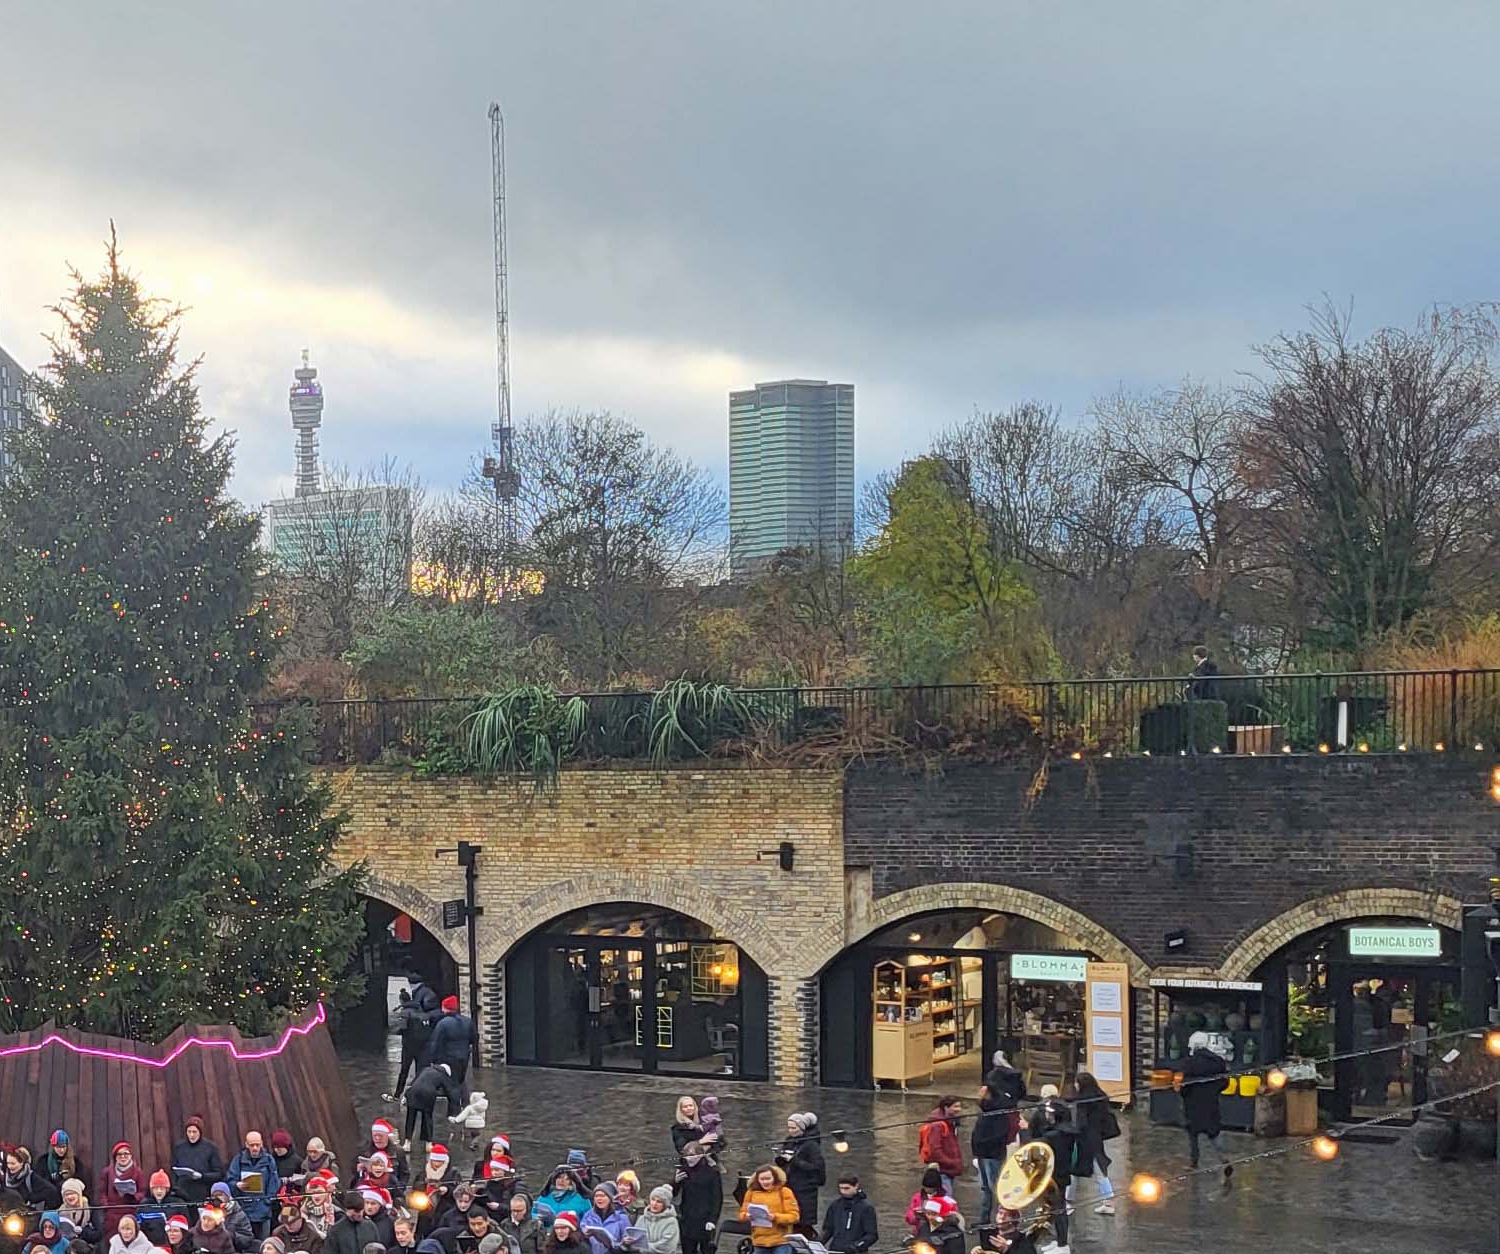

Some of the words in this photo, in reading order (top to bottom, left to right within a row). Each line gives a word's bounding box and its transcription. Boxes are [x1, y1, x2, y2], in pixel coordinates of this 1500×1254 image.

[1355, 936, 1407, 948] BOTANICAL
[1408, 937, 1435, 949] BOYS
[1021, 960, 1079, 971] BLOMMA
